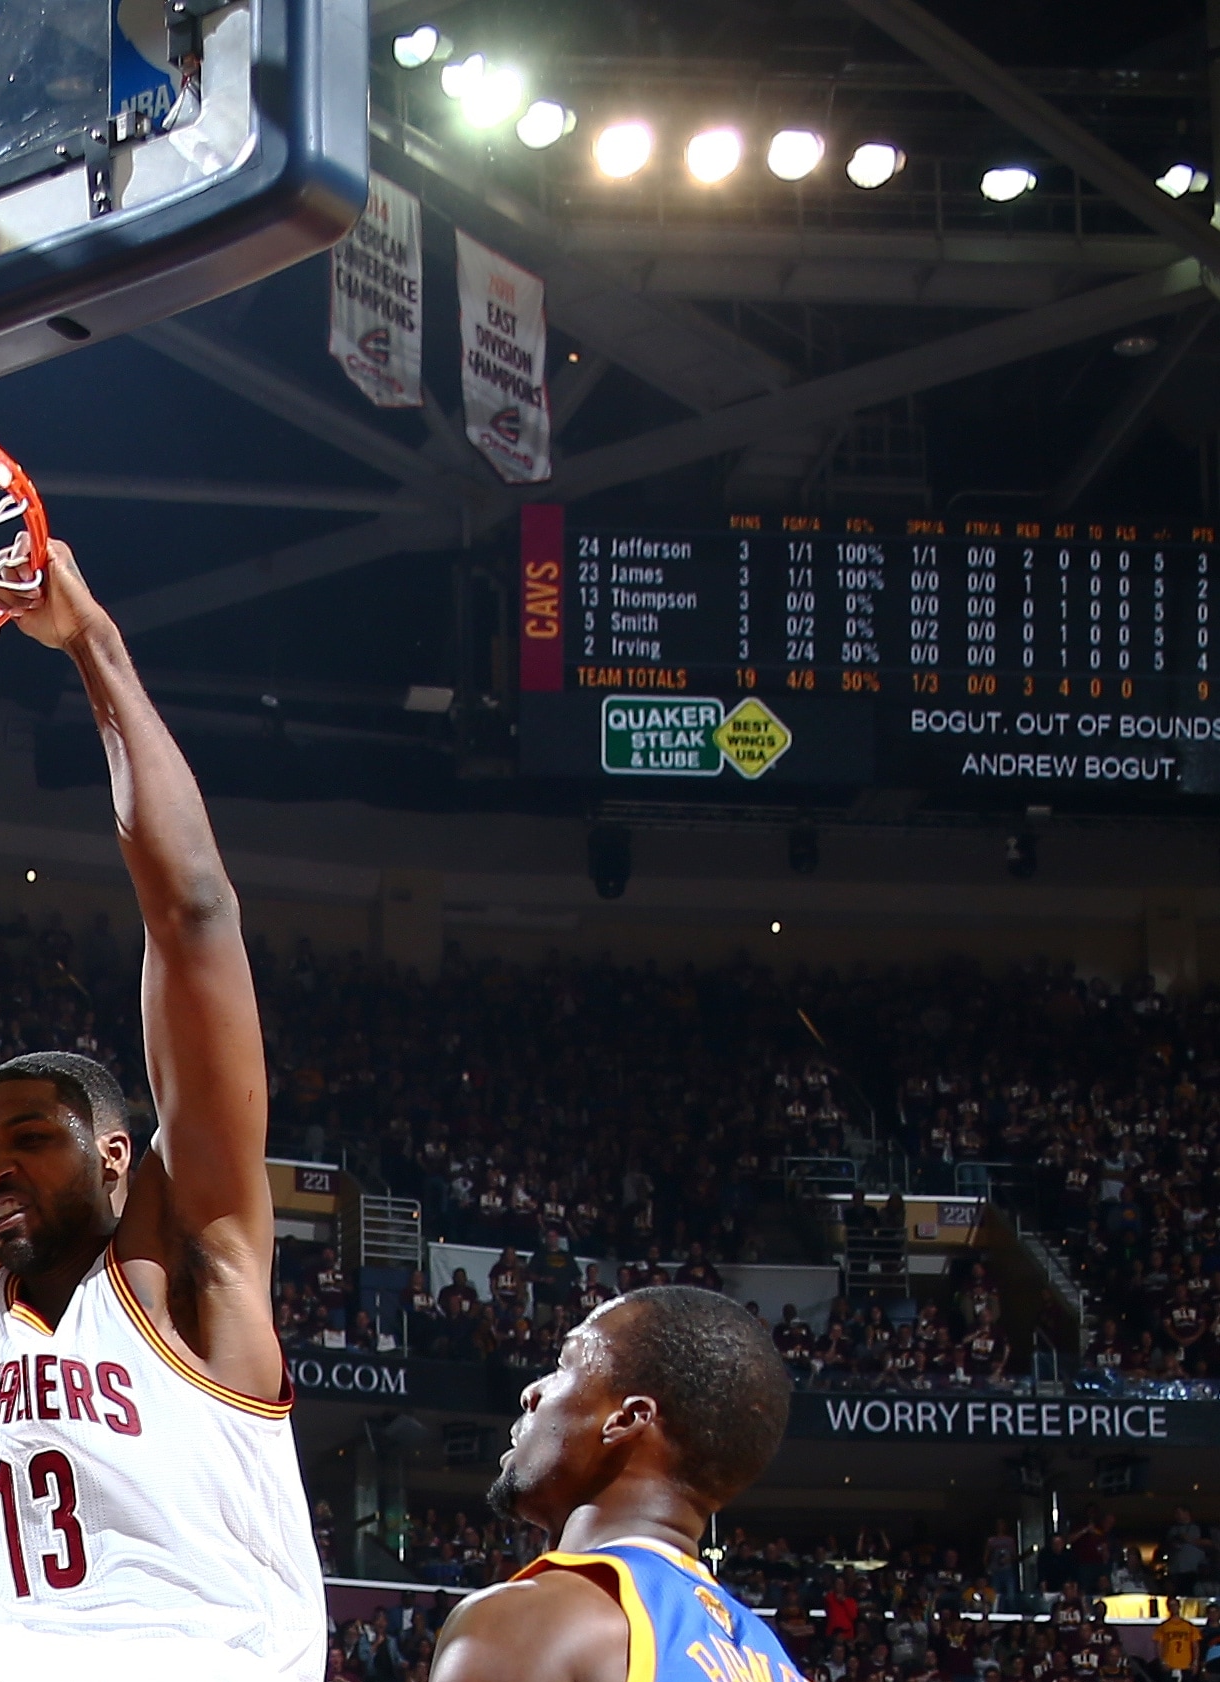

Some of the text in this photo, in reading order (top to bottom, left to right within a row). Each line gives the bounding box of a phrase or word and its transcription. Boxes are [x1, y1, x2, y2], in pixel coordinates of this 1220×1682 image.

[487, 303, 517, 337] EAST
[476, 325, 532, 376] DIVISION
[579, 537, 1207, 573] 24 Jefferson 3 1/1 100% 1/1 0/0 2 0 0 0 5 3
[579, 562, 1208, 598] 23 James 3 1/1 100% 0/0 0/0 1 1 0 0 5 2
[525, 561, 559, 639] CAVS
[580, 587, 1207, 622] 13 Thompson 3 0/0 0% 0/0 0/0 0 1 0 0 5 0
[585, 612, 1207, 647] 5 Smith 3 0/2 0% 0/2 0/0 0 1 0 0 5 0
[585, 635, 1207, 671] 2 Irving 3 2/4 50% 0/0 0/0 0 1 0 0 5 4
[578, 667, 1208, 699] TEAM TOTALS 19 4/8 50% 1/3 0/0 3 4 0 0 9
[608, 706, 717, 731] QUAKER
[732, 720, 770, 733] BEST
[910, 709, 1008, 734] BOGUT.
[1015, 712, 1071, 735] OUT
[1077, 714, 1112, 737] OF
[631, 731, 706, 749] STEAK
[727, 735, 776, 748] WINGS
[735, 749, 765, 762] USA
[631, 751, 700, 768] & LUBE
[962, 753, 1181, 781] ANDREW BOGUT.
[303, 1171, 331, 1191] 221
[826, 1400, 1167, 1438] WORRY FREE PRICE
